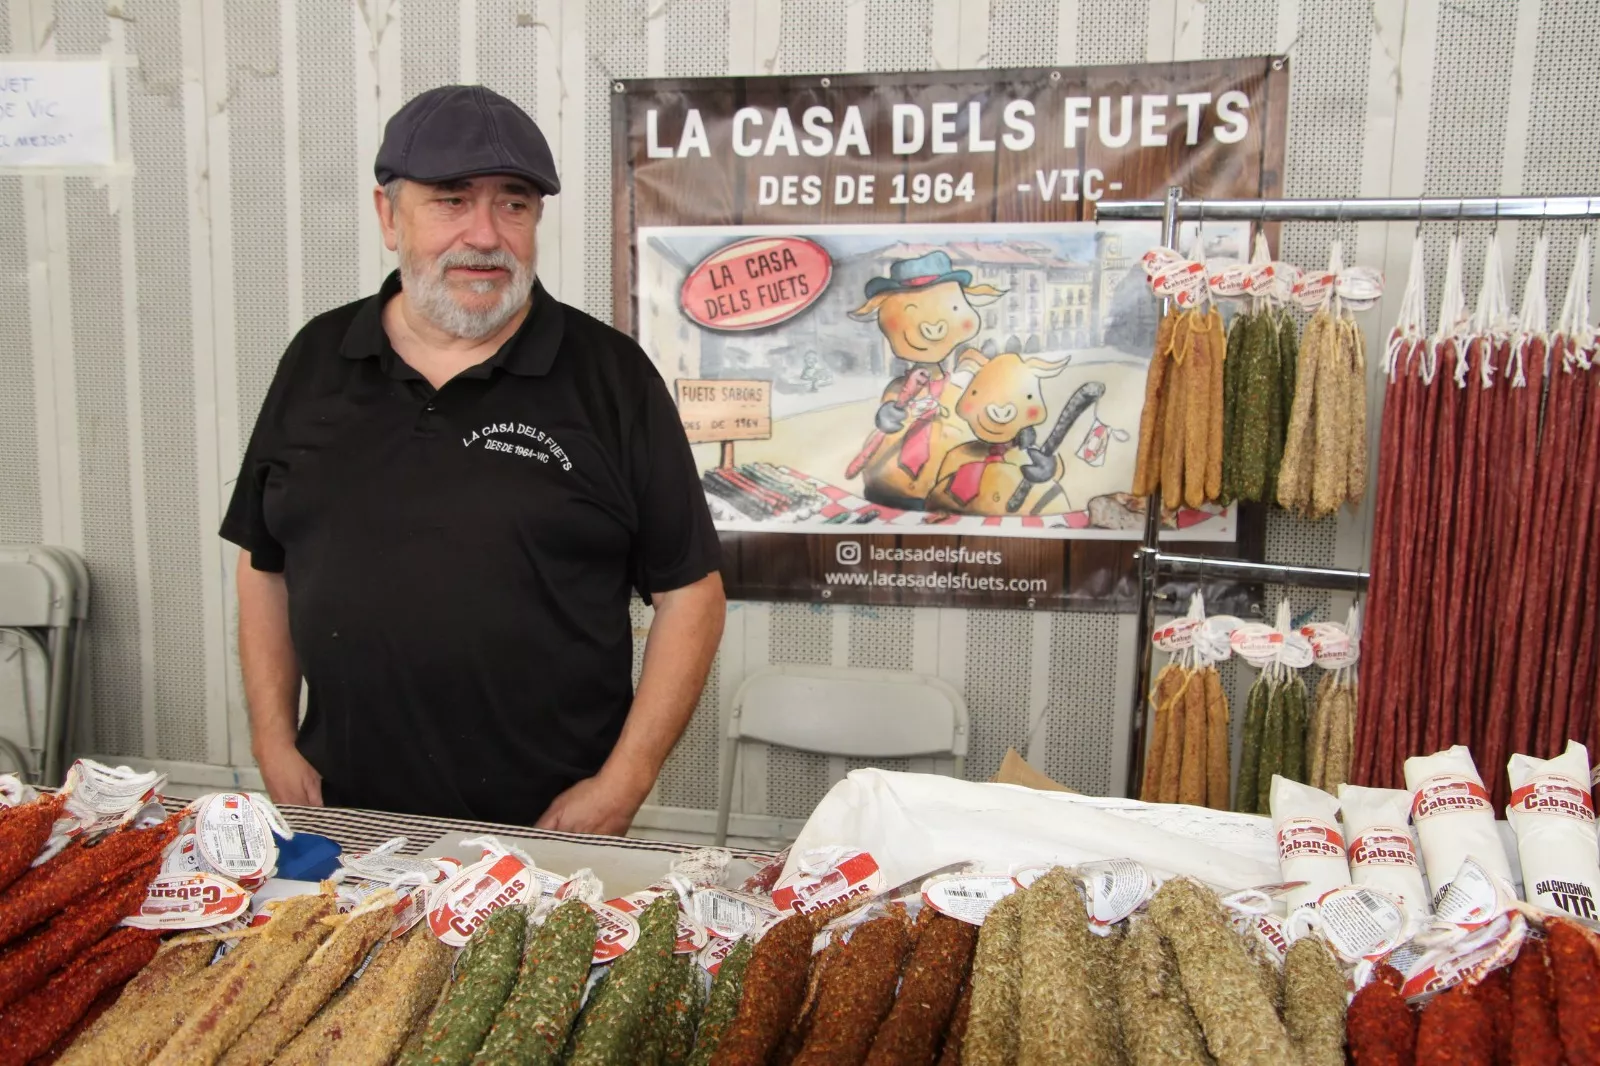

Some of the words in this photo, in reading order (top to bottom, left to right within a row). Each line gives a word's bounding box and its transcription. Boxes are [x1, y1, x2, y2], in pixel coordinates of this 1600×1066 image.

[646, 109, 711, 158] LA
[731, 105, 871, 157] CASA
[892, 99, 1036, 155] DELS
[1064, 90, 1249, 148] FUETS
[759, 175, 822, 206] DES
[834, 174, 875, 205] DE
[889, 172, 975, 204] 1964
[1017, 168, 1123, 202] -VIC-
[708, 264, 734, 290] LA
[745, 247, 797, 280] CASA
[704, 287, 752, 320] DELS
[757, 273, 809, 307] FUETS
[682, 386, 715, 402] FUETS
[721, 386, 763, 402] SABORS
[463, 431, 480, 447] LA
[482, 422, 514, 436] CASA
[516, 423, 546, 441] DELS
[544, 437, 573, 471] FUETS
[870, 545, 1003, 564] lacasadelsfuets
[825, 569, 1048, 592] www.lacasadelsfuets.com
[1418, 796, 1484, 816] Cabanas
[1524, 793, 1593, 820] Cabanas
[146, 885, 221, 903] Caban
[1535, 879, 1593, 899] SALCHICHÓN
